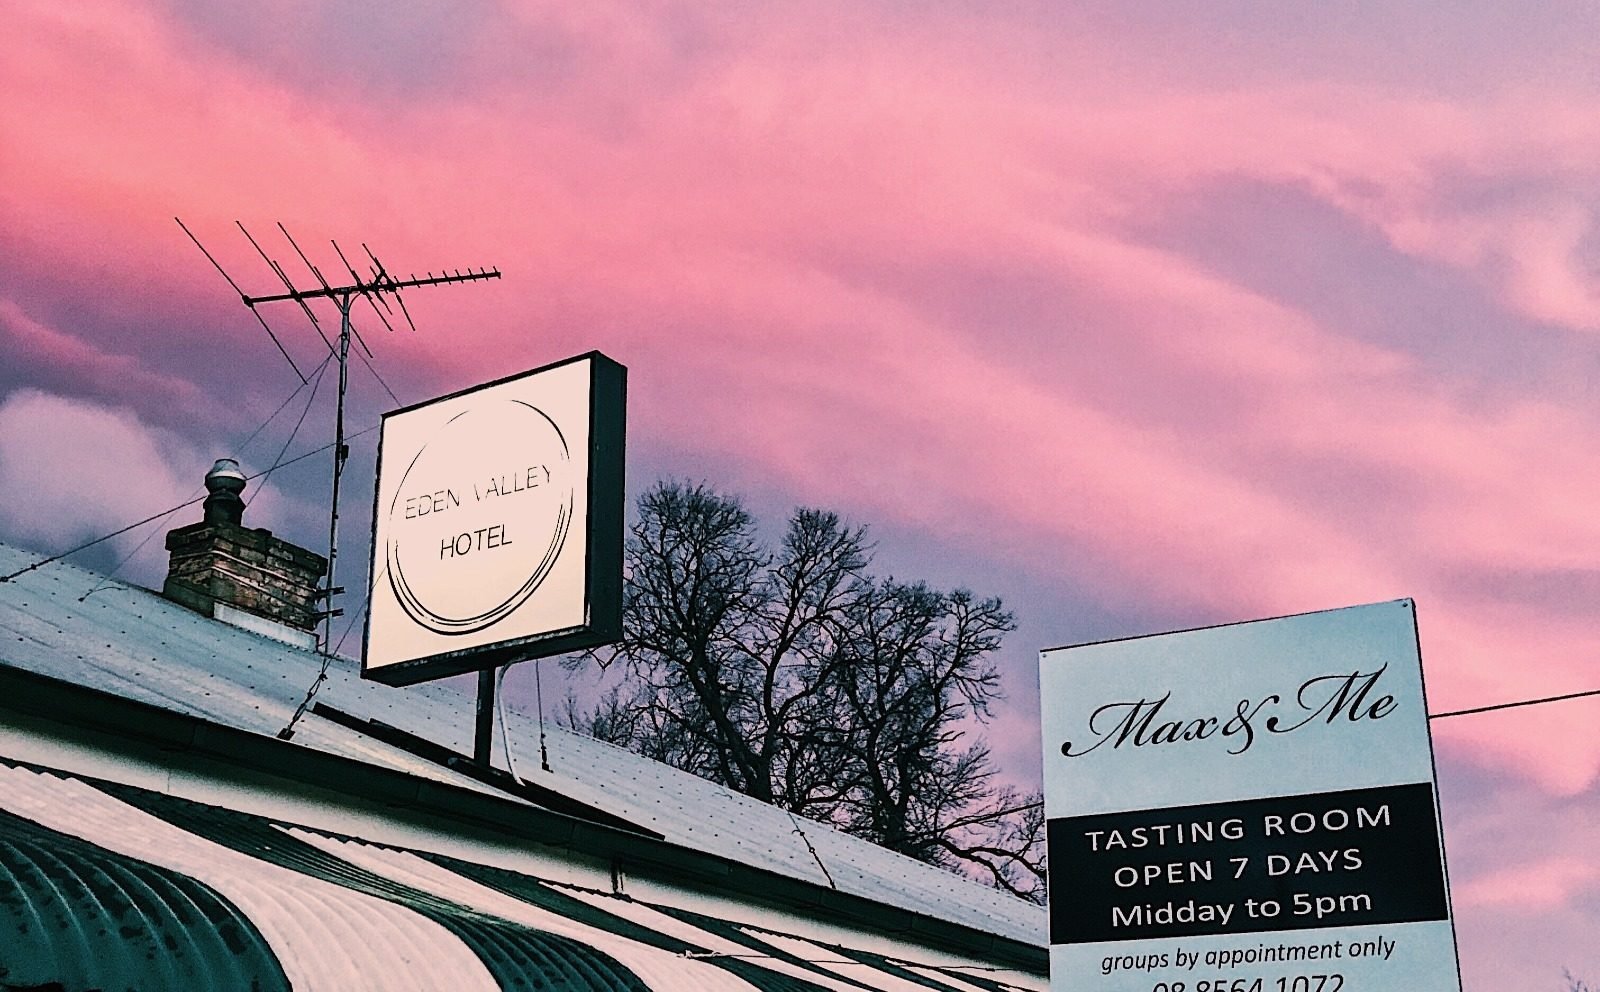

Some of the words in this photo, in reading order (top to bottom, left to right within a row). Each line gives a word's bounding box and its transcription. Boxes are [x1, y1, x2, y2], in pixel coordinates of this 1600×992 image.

[405, 488, 460, 520] EDEN
[440, 523, 513, 561] HOTEL
[1084, 818, 1245, 853] TASTING
[1263, 804, 1392, 838] ROOM
[1113, 860, 1213, 889] OPEN
[1228, 857, 1250, 880] 7
[1266, 847, 1364, 877] DAYS
[1111, 900, 1235, 928] Midday
[1244, 897, 1281, 919] to
[1292, 892, 1373, 918] 5pm
[1100, 951, 1169, 975] groups
[1175, 947, 1200, 971] by
[1204, 940, 1343, 970] appointment
[1348, 935, 1396, 960] only
[1276, 973, 1345, 992] 1072
